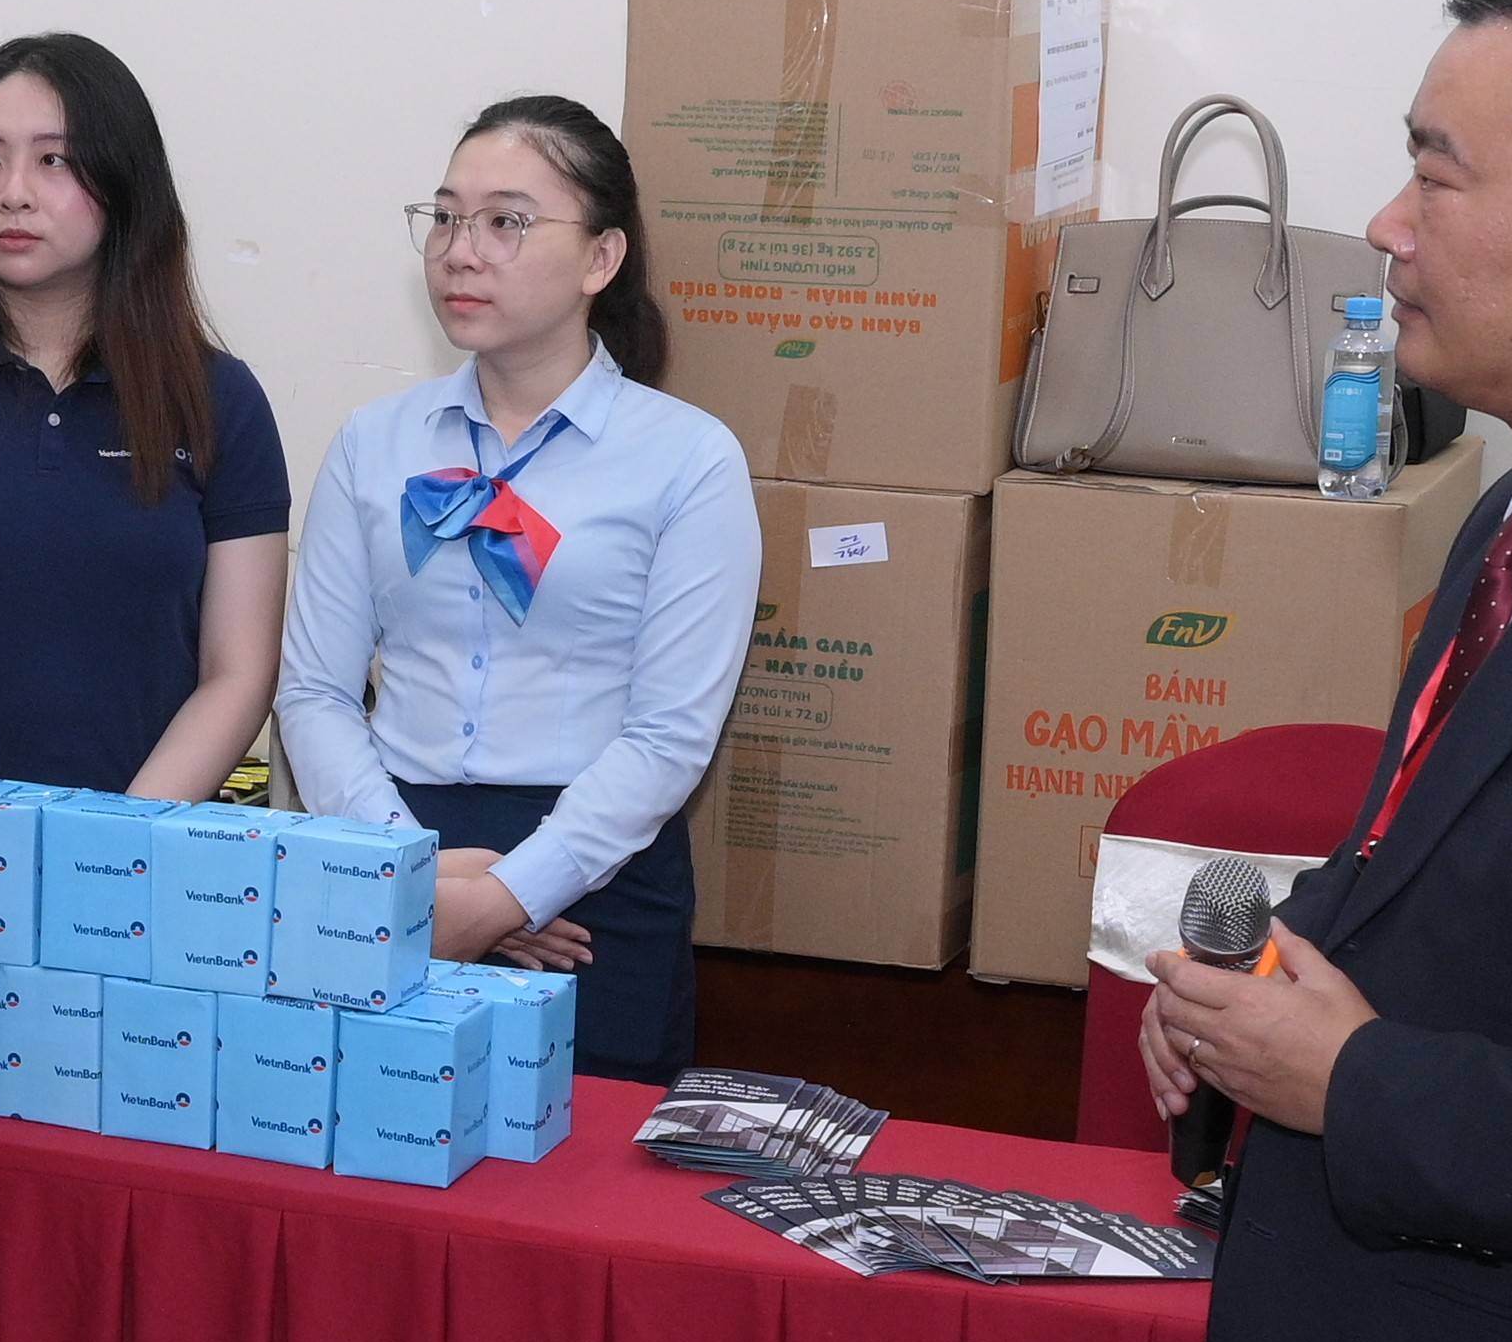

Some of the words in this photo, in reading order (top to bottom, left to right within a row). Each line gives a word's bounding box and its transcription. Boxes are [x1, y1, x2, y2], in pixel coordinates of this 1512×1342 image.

[738, 240, 756, 252] 72
[758, 242, 768, 251] x
[769, 239, 789, 254] túi
[791, 240, 814, 256] (36
[816, 241, 834, 257] kg
[836, 245, 876, 258] 2.592
[739, 259, 770, 272] TỊNH
[823, 263, 856, 276] KHỐI
[669, 280, 717, 304] BIỂN
[724, 282, 784, 301] RONG
[806, 288, 868, 307] NHÂN
[876, 288, 938, 307] HẠNH
[682, 307, 739, 324] GABA
[809, 311, 854, 330] GẠO
[861, 318, 921, 337] BÁNH
[1156, 615, 1219, 644] FnV
[754, 627, 808, 650] MẦM
[816, 638, 874, 657] GABA
[765, 660, 808, 679] HẠT
[737, 686, 778, 699] ƯỢNG
[780, 690, 811, 702] TỊNH
[1145, 670, 1226, 707] BÁNH
[738, 701, 759, 716] (36
[764, 705, 781, 717] túi
[795, 708, 812, 720] 72
[1024, 709, 1109, 755] GẠO
[1120, 714, 1220, 758] MẦM
[1006, 764, 1084, 799] HẠNH
[1093, 770, 1149, 800] NH
[187, 827, 246, 843] VietinBank
[74, 861, 133, 878] VietinBank
[322, 860, 380, 880] VietinBank
[185, 890, 245, 906] VietinBank
[73, 922, 131, 940] VietinBank
[317, 924, 375, 945] VietinBank
[185, 952, 244, 968] VietinBank
[312, 987, 371, 1008] VietinBank
[52, 1005, 104, 1019] VietinBan
[122, 1030, 178, 1050] VietinBank
[54, 1065, 104, 1080] VietinBan
[255, 1053, 312, 1075] VietinBank
[379, 1064, 440, 1085] VietinBank
[120, 1091, 177, 1111] VietinBank
[251, 1115, 308, 1137] VietinBank
[376, 1126, 437, 1148] VietinBank
